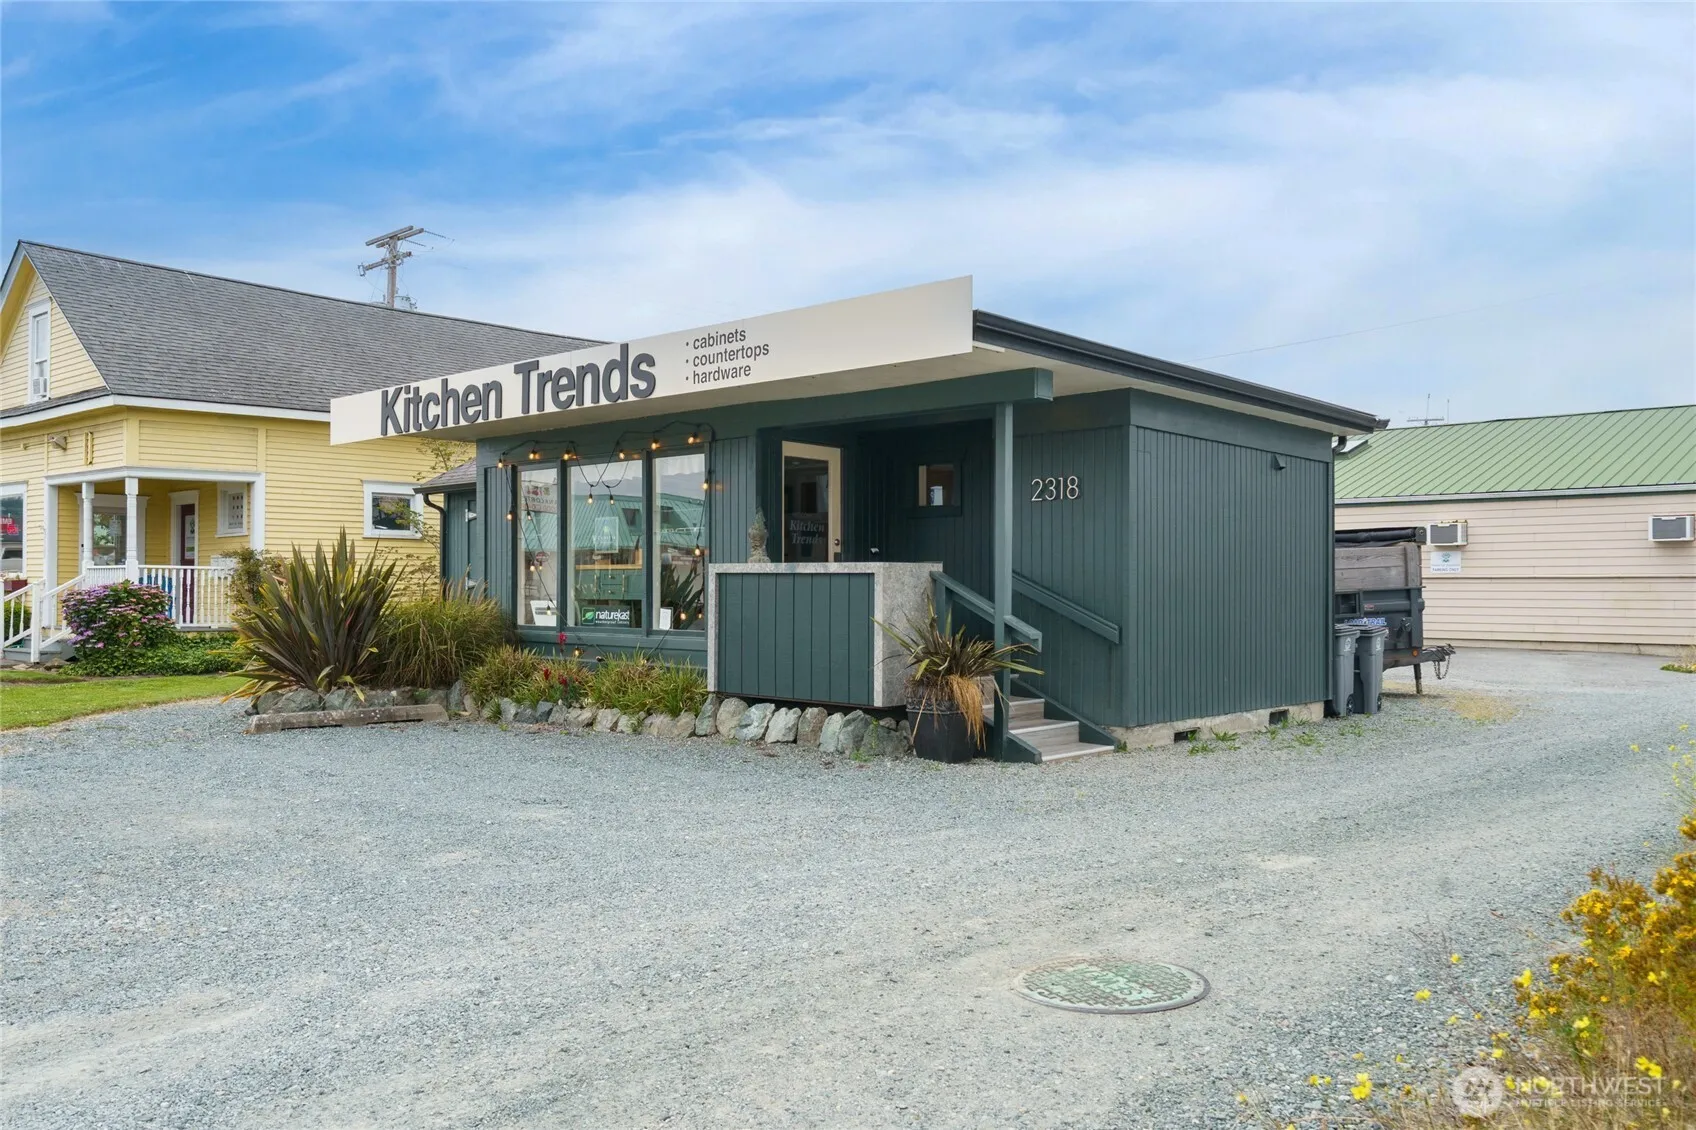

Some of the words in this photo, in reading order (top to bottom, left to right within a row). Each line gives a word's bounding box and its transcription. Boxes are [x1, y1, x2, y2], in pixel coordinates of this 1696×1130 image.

[693, 328, 746, 350] cabinets
[693, 343, 769, 367] countertops
[693, 364, 751, 384] hardware
[381, 378, 503, 436] Kitchen
[513, 343, 657, 415] Trends
[1031, 475, 1079, 501] 2318
[789, 519, 825, 532] Kitchen
[792, 532, 827, 545] Trends
